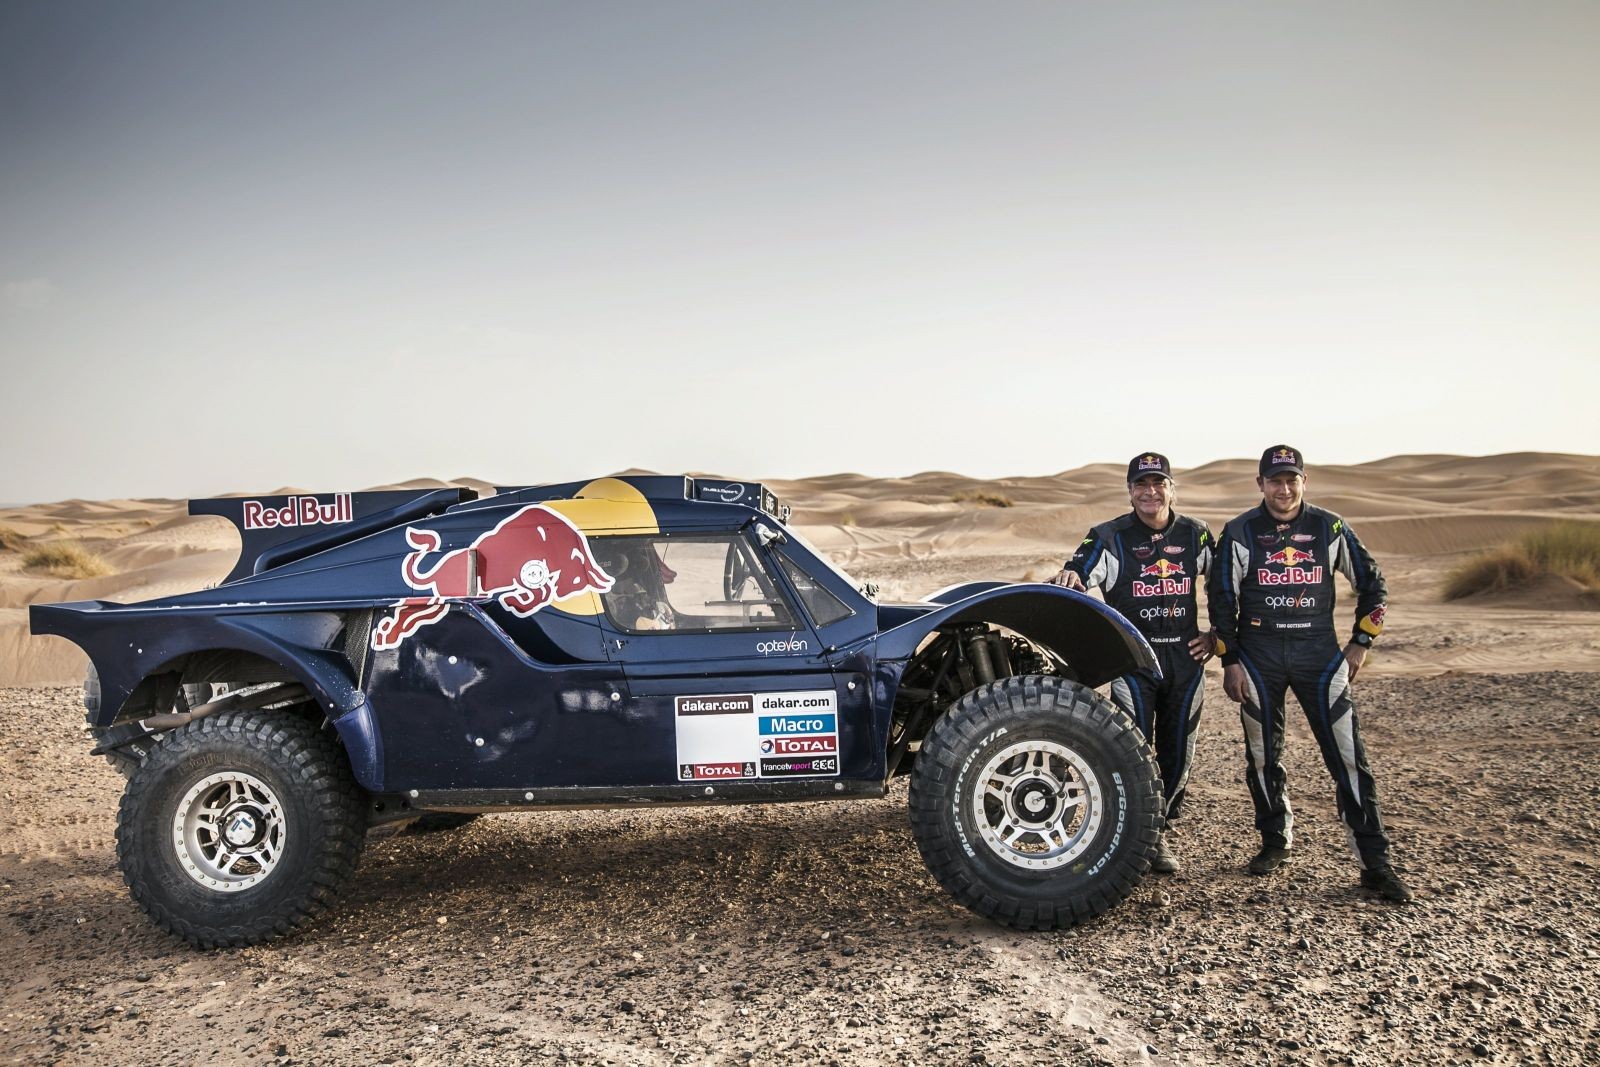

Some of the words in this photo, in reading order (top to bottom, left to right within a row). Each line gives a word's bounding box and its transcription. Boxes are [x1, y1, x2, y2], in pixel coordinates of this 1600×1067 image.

[244, 497, 298, 528] Red
[300, 493, 352, 525] Bull
[1258, 567, 1292, 585] Red
[1292, 566, 1323, 584] Bull
[1133, 579, 1165, 597] Red
[1165, 577, 1191, 595] Bull
[1265, 589, 1315, 610] opteven
[1140, 599, 1185, 621] opteven
[757, 632, 808, 655] opteven
[681, 700, 749, 712] dakar.com
[762, 698, 830, 709] dakar.com
[771, 718, 823, 732] Macro
[777, 739, 835, 752] TOTAL
[980, 727, 1008, 747] T/A
[696, 765, 741, 776] TOTAL
[1087, 772, 1127, 876] BFGoodrich
